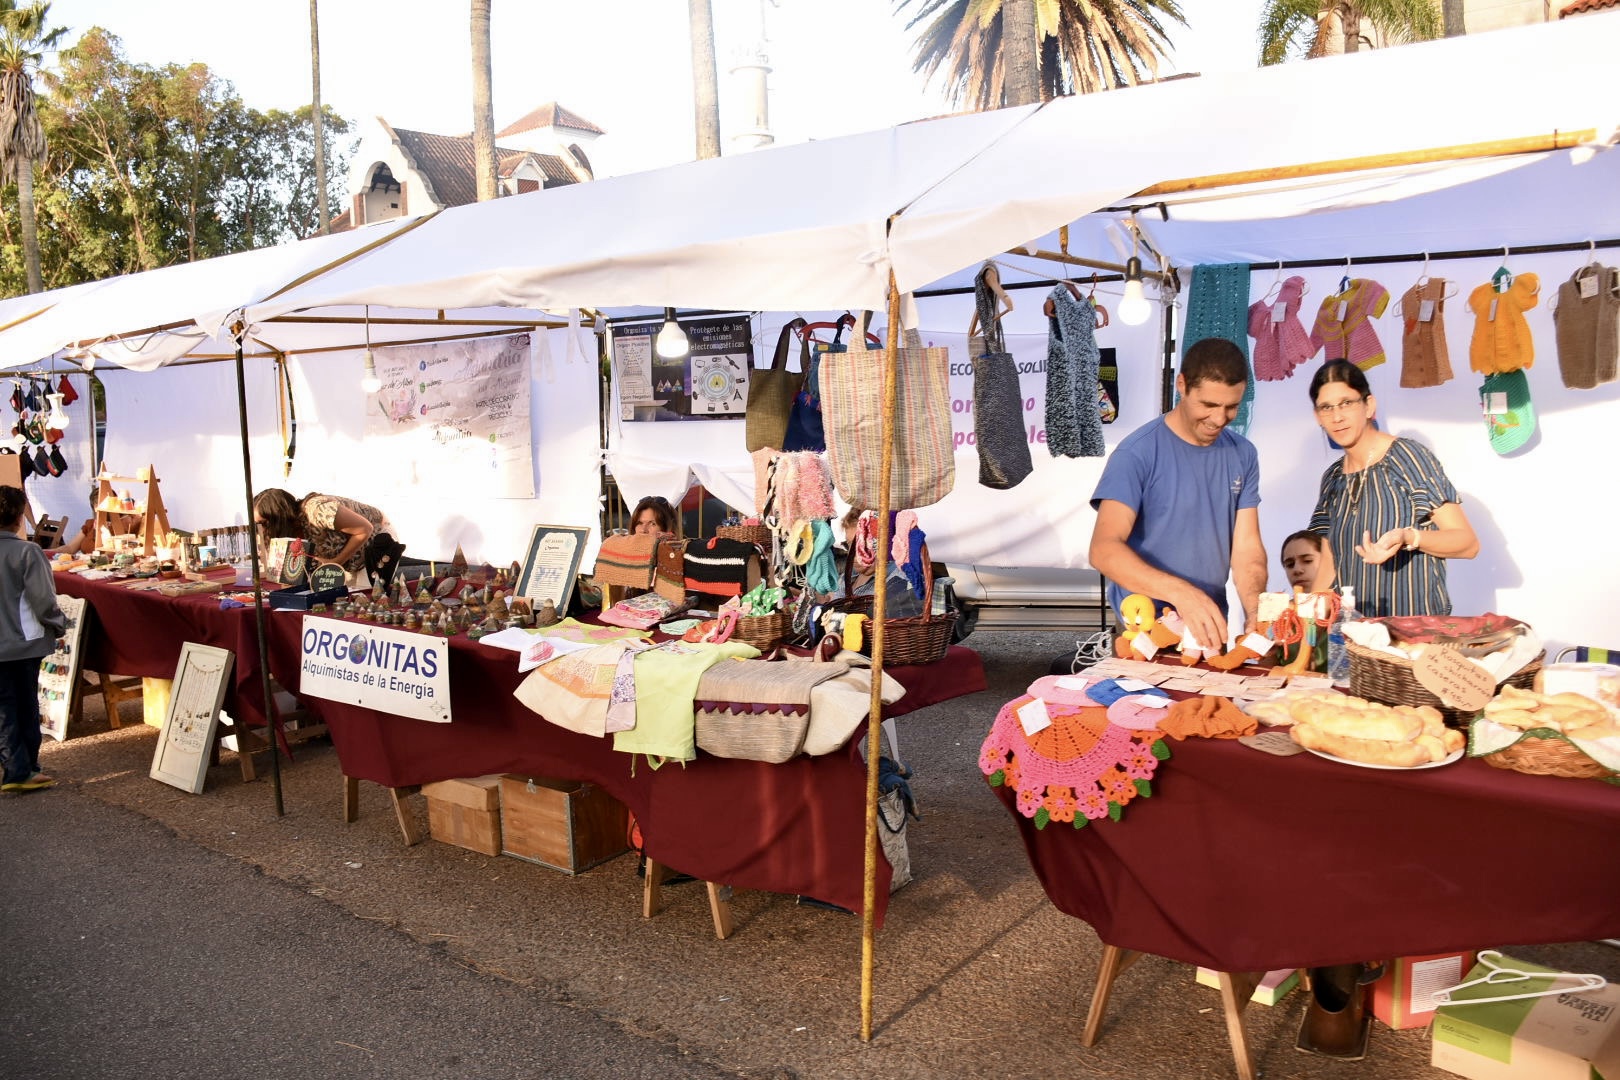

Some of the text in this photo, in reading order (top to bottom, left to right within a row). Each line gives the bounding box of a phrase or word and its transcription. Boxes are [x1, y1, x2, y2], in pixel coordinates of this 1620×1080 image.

[702, 333, 733, 342] emisiones
[722, 323, 730, 332] de
[732, 323, 743, 331] las
[303, 628, 438, 678] ORGONITAS
[1427, 654, 1439, 664] de
[1441, 647, 1487, 682] Rosquitas
[302, 659, 434, 700] Alquimistas de la Energía
[1426, 664, 1467, 694] caseras
